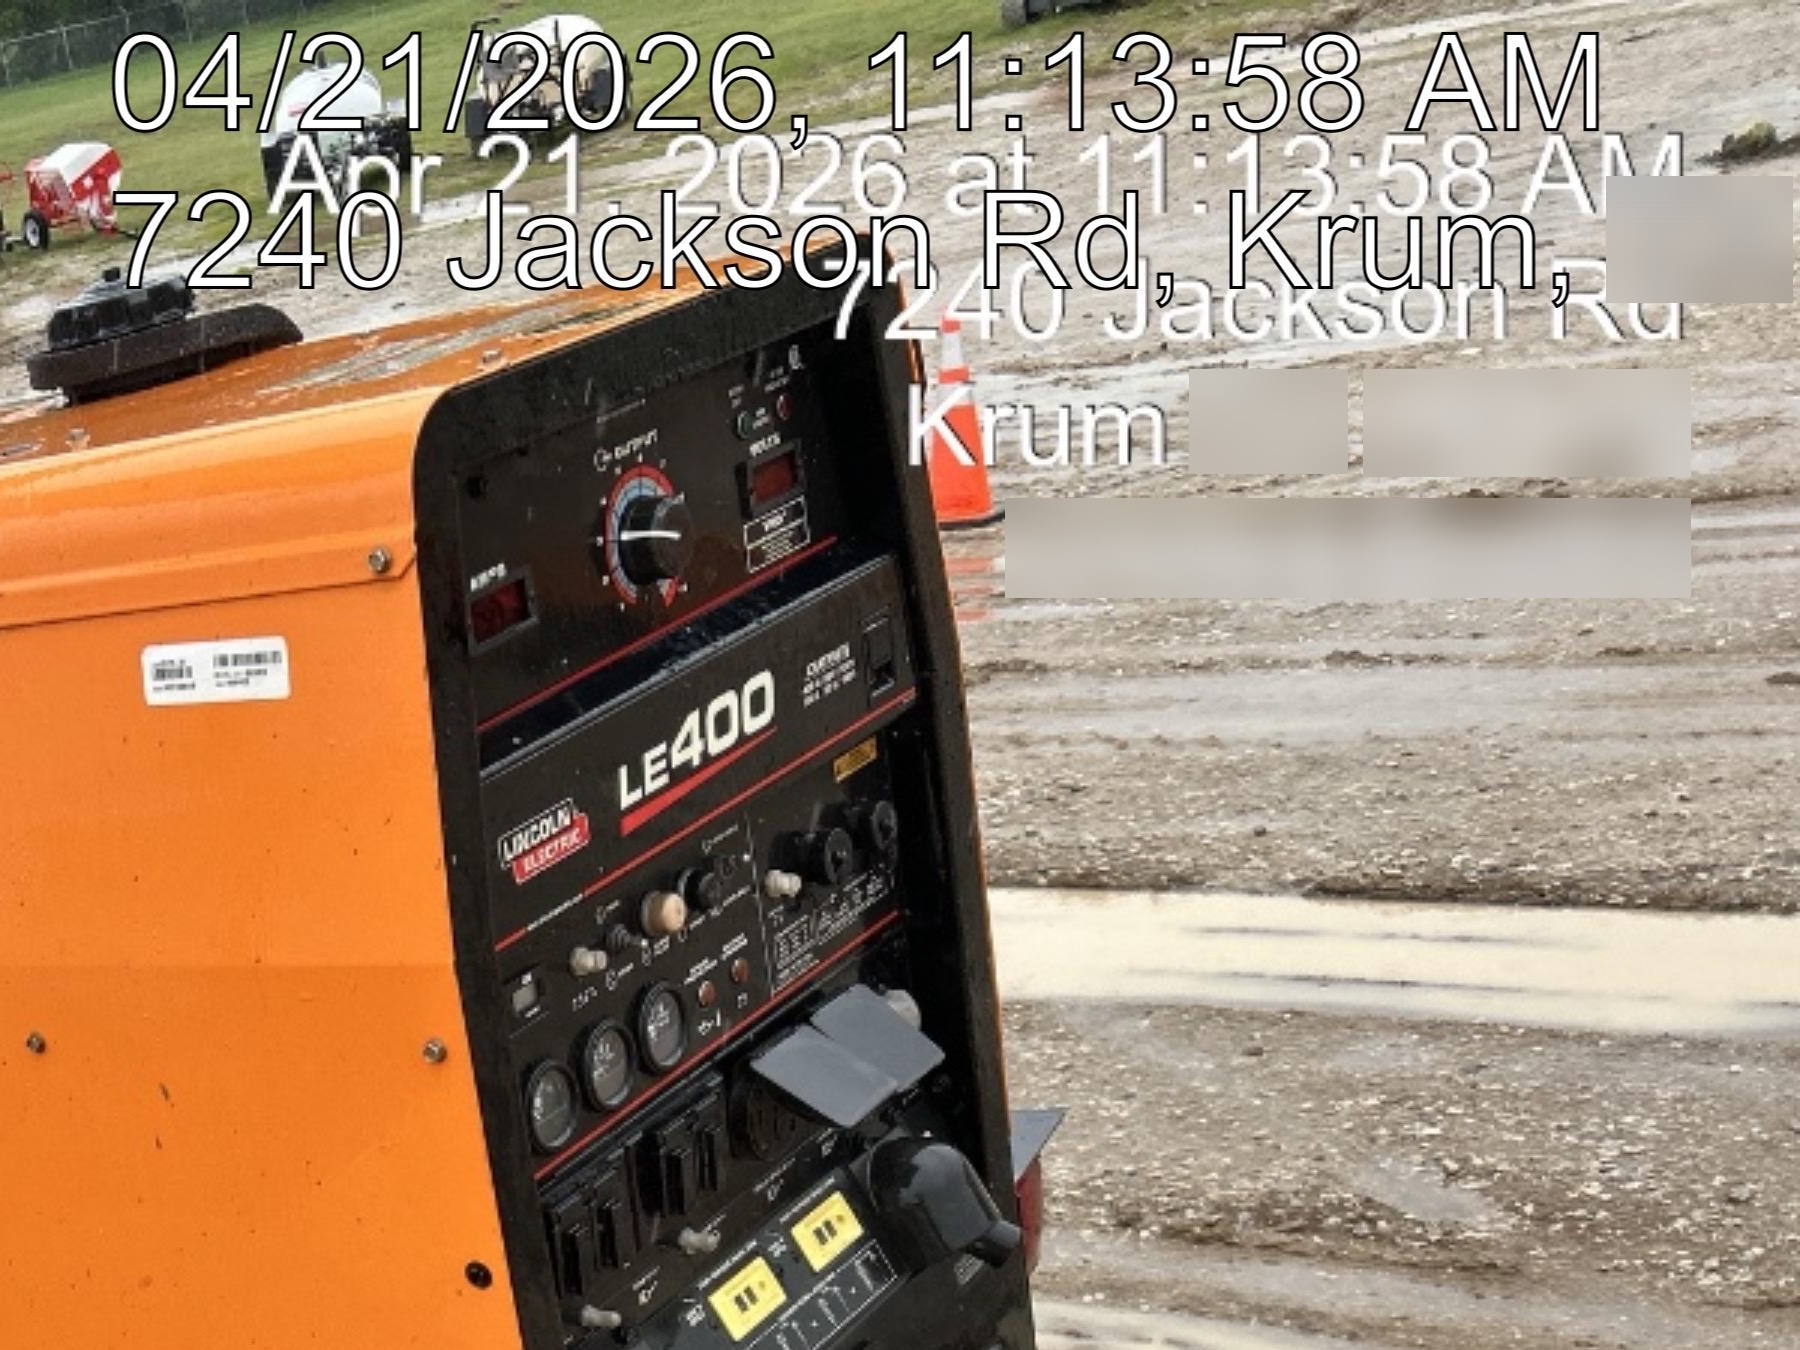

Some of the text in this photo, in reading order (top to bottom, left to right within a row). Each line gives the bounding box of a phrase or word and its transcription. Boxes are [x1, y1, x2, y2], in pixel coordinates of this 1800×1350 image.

[618, 669, 776, 811] LE400
[503, 805, 571, 861] LINCOLN
[523, 827, 582, 874] ELECTRIC
